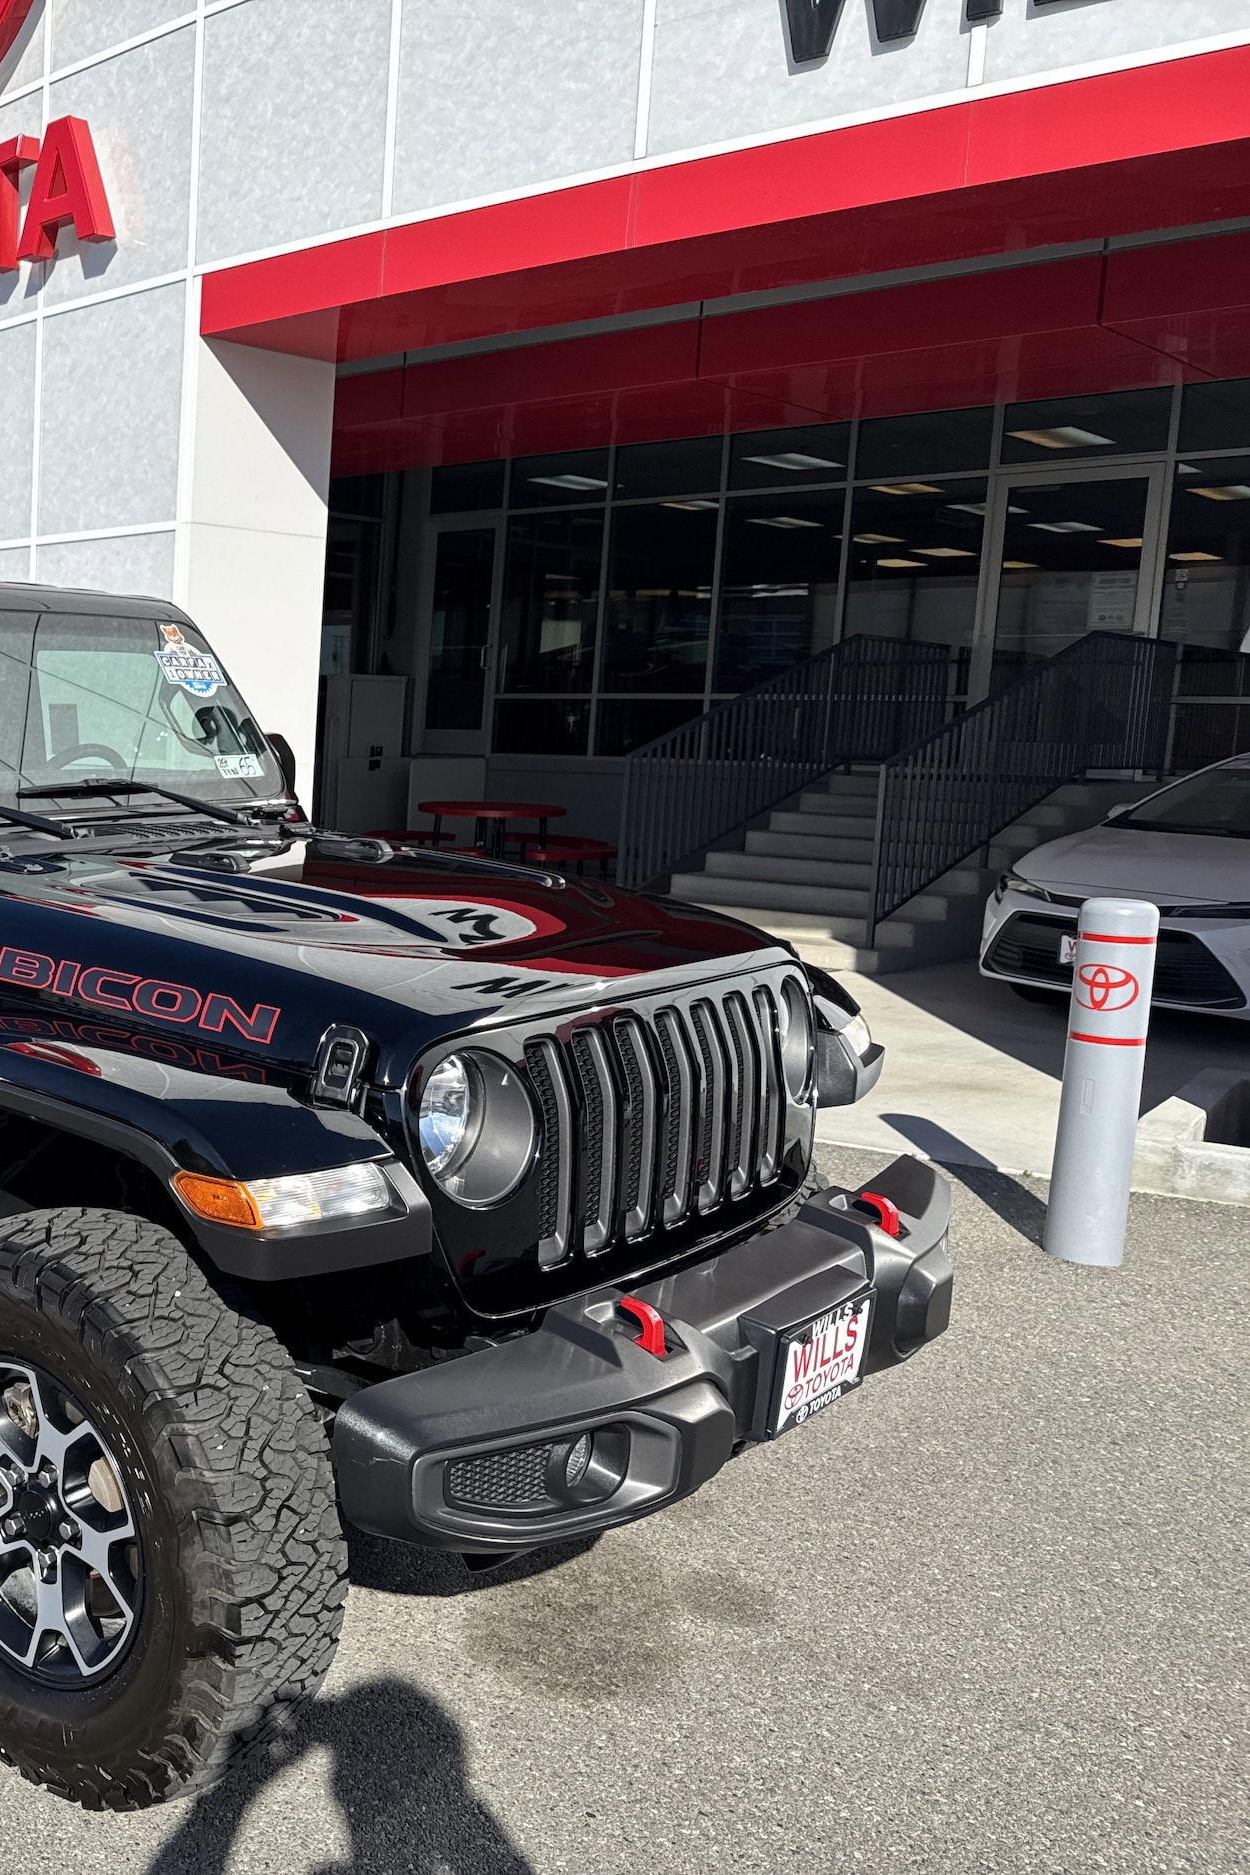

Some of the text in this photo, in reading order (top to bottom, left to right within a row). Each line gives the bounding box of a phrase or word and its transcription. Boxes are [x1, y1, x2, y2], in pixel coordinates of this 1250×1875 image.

[161, 656, 214, 669] CARFAX
[811, 1301, 854, 1338] WILLS
[793, 1314, 859, 1383] WILLS
[805, 1353, 855, 1399] TOYOTA
[809, 1385, 842, 1415] TOYOTA
